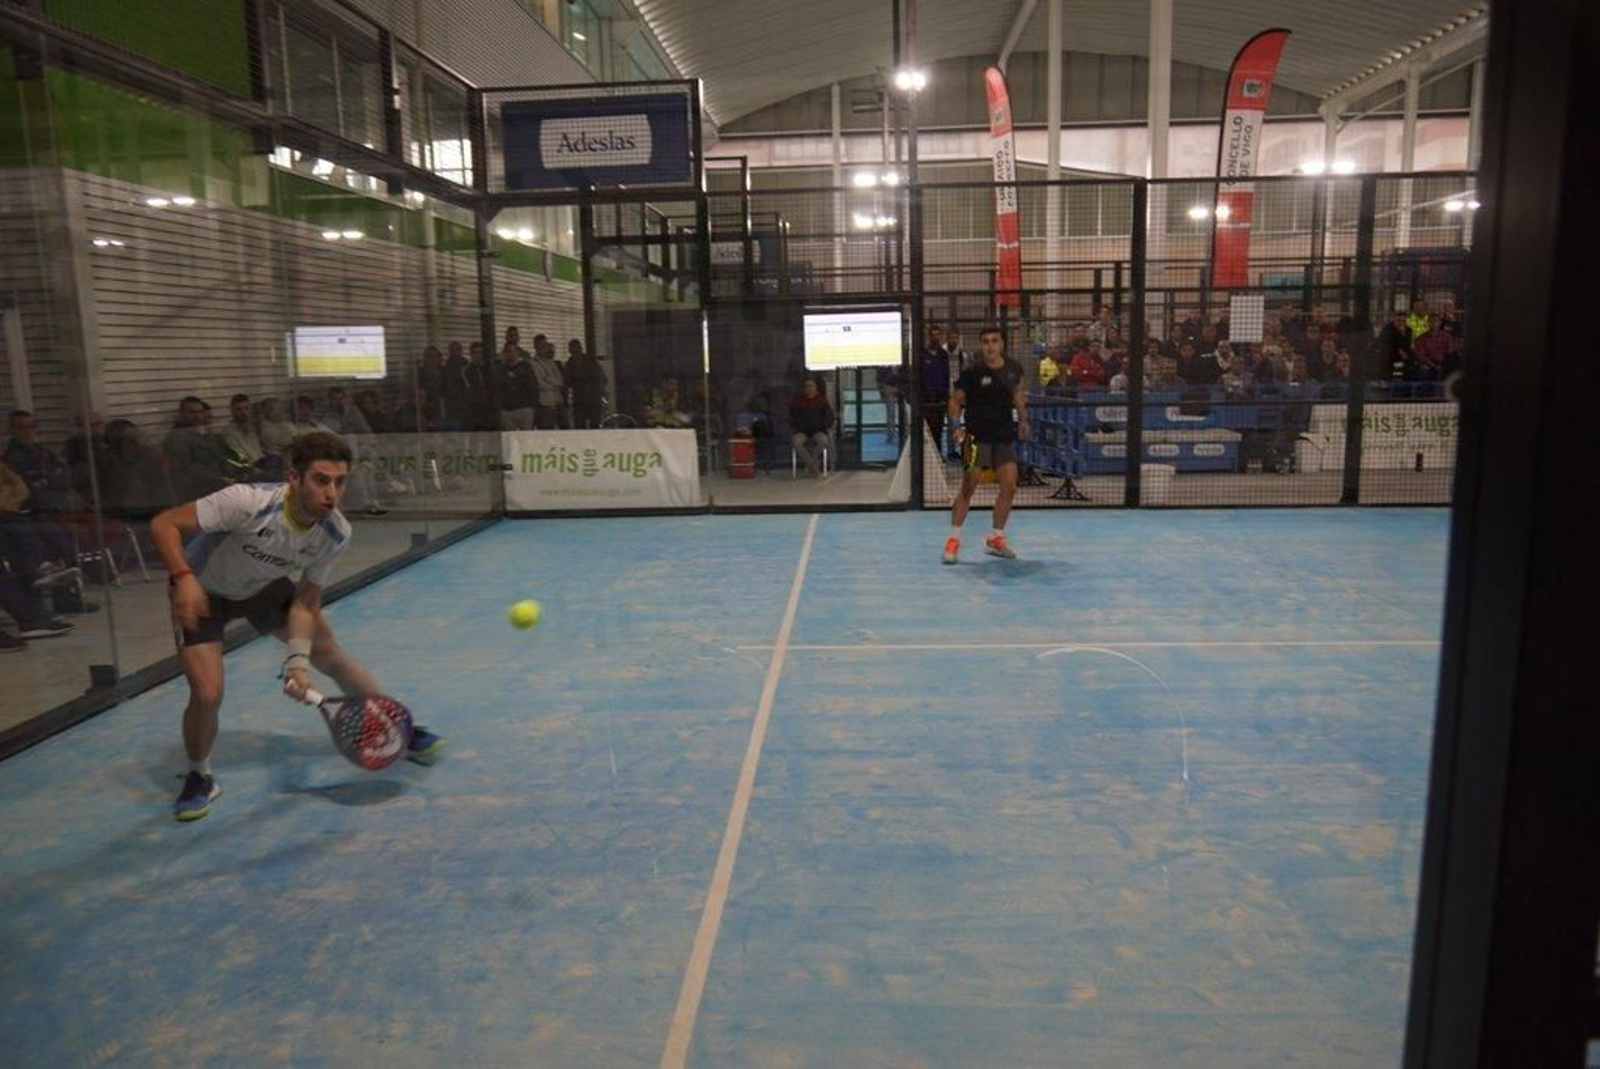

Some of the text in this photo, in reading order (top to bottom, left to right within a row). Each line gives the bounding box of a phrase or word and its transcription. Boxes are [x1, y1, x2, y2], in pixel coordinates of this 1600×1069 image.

[556, 129, 636, 154] Adeslas
[1241, 124, 1253, 157] VIGO
[521, 446, 579, 474] máis
[602, 451, 662, 478] auga
